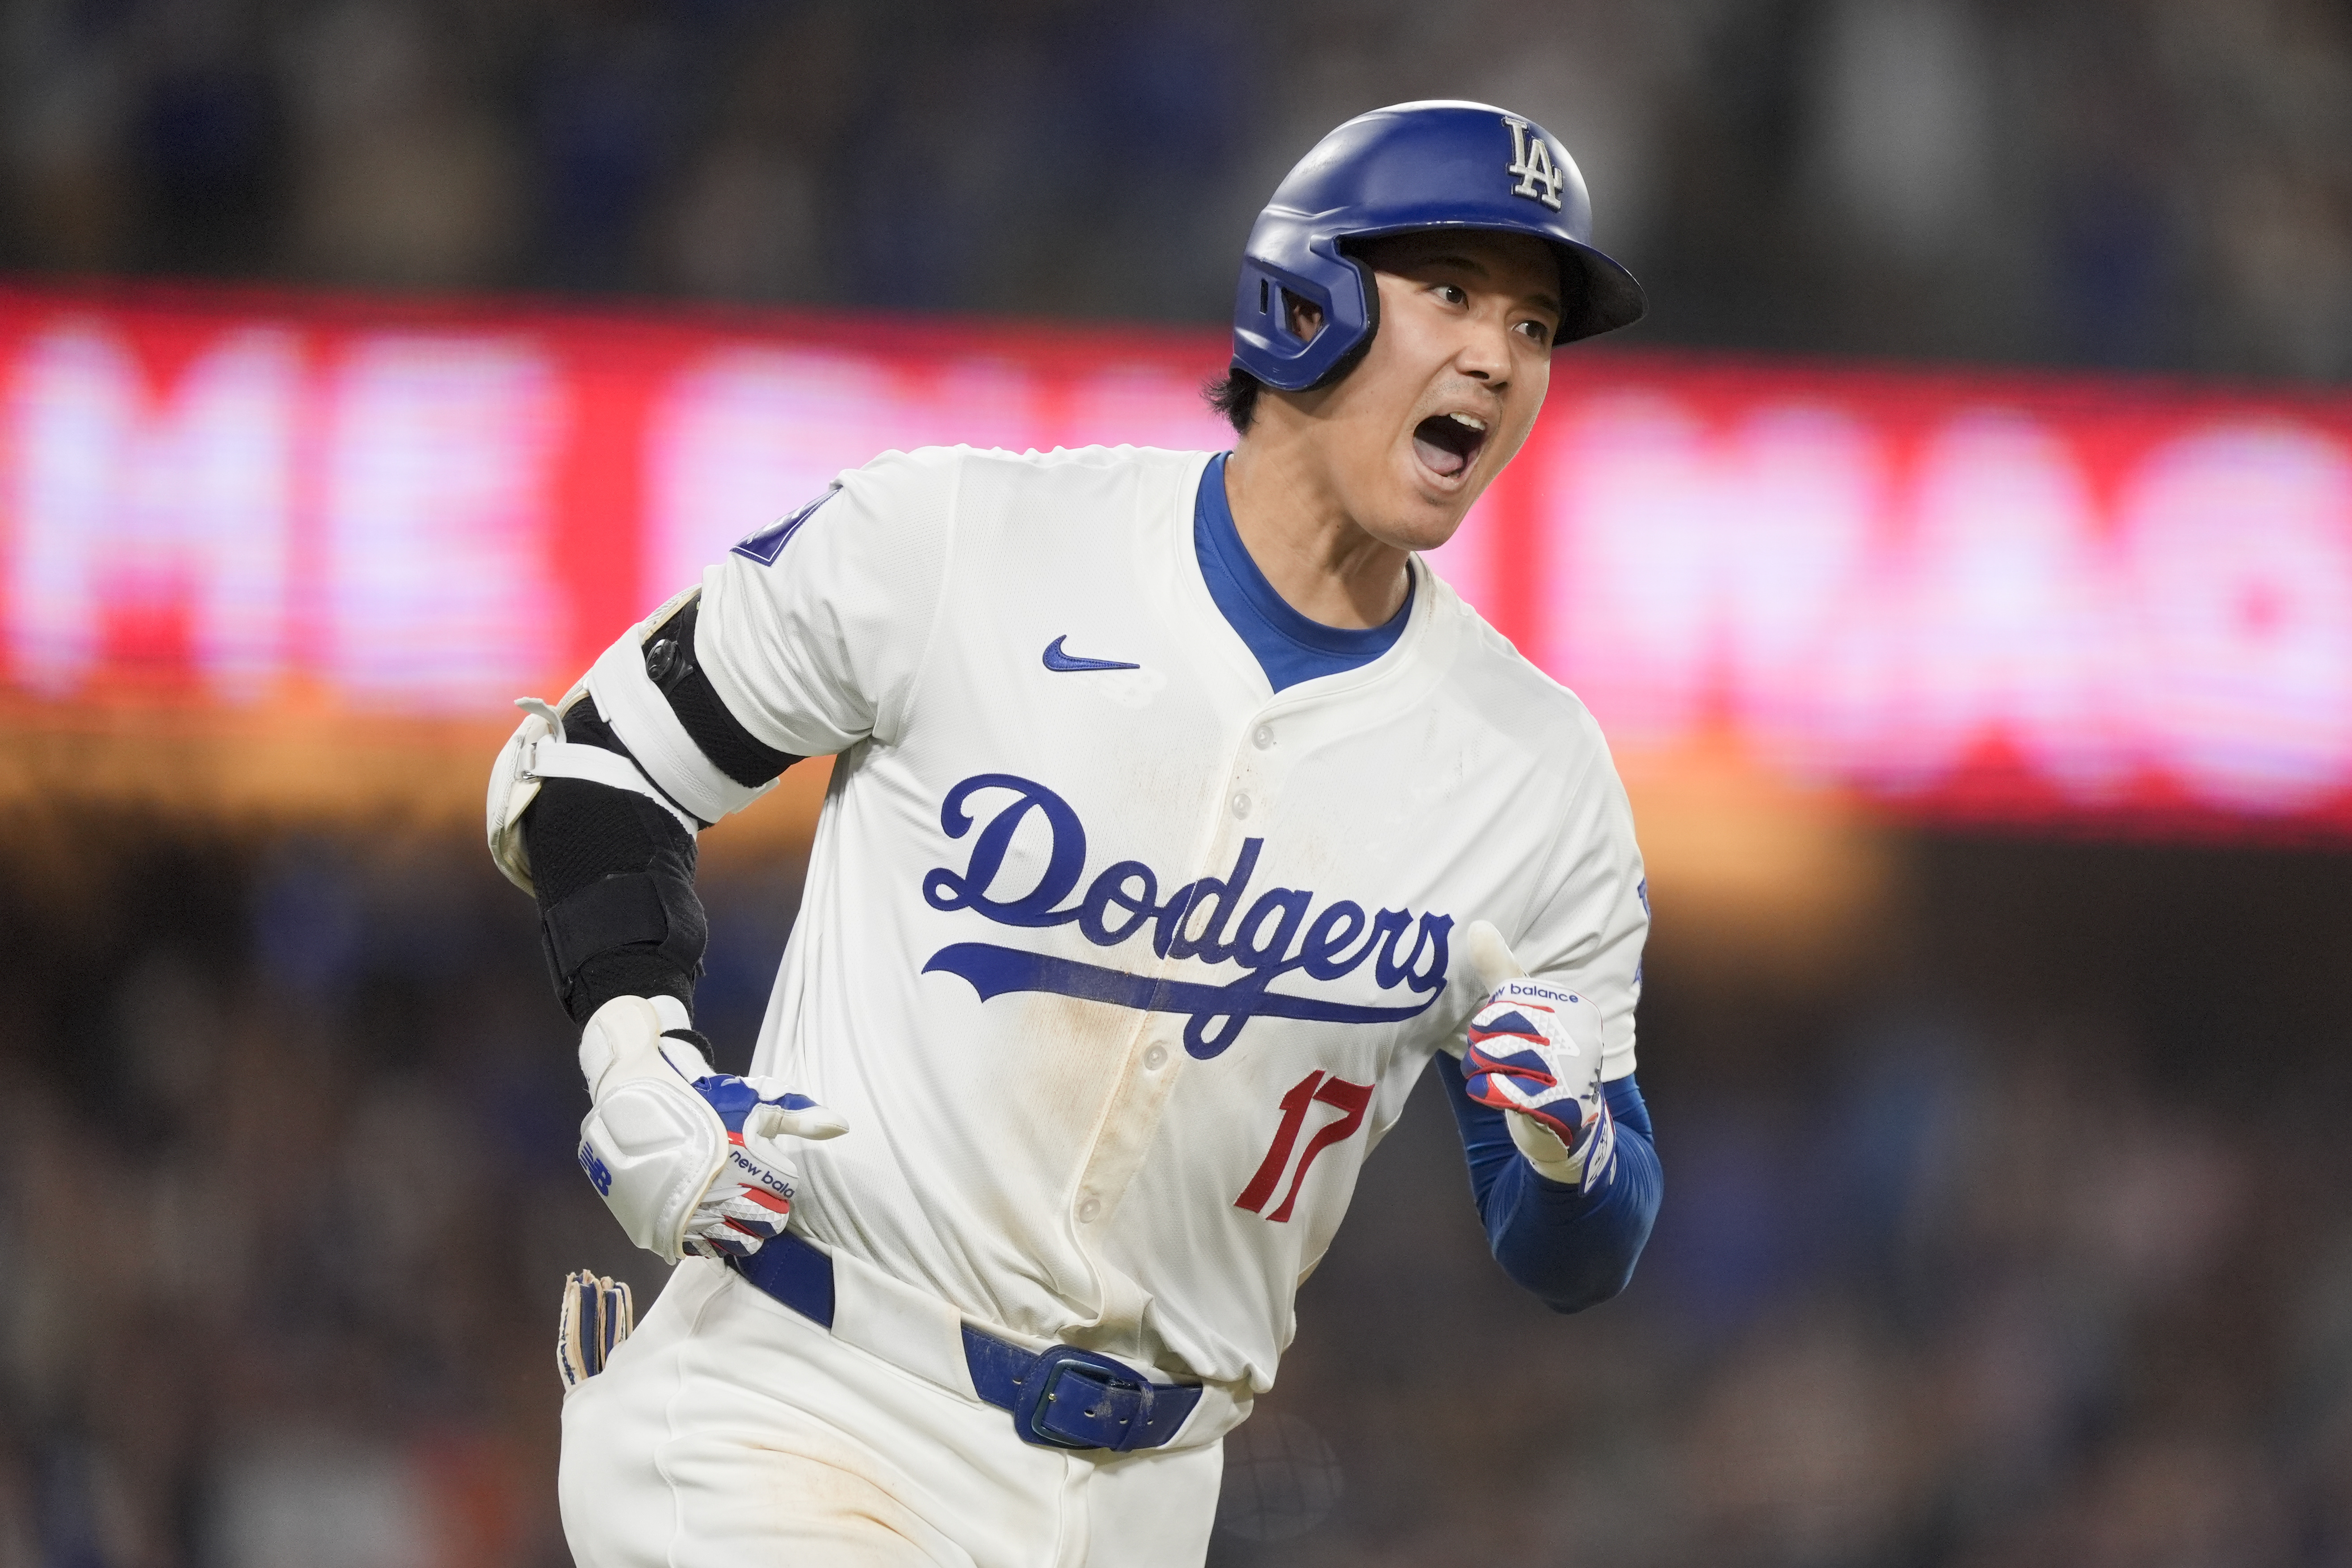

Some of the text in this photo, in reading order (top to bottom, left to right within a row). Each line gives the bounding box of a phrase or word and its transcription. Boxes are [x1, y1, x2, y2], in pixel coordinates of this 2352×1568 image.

[1501, 116, 1563, 212] LA
[921, 773, 1455, 1060] Dodgers
[1510, 984, 1579, 1003] balance
[729, 1150, 762, 1176] new
[1233, 1069, 1376, 1223] 17
